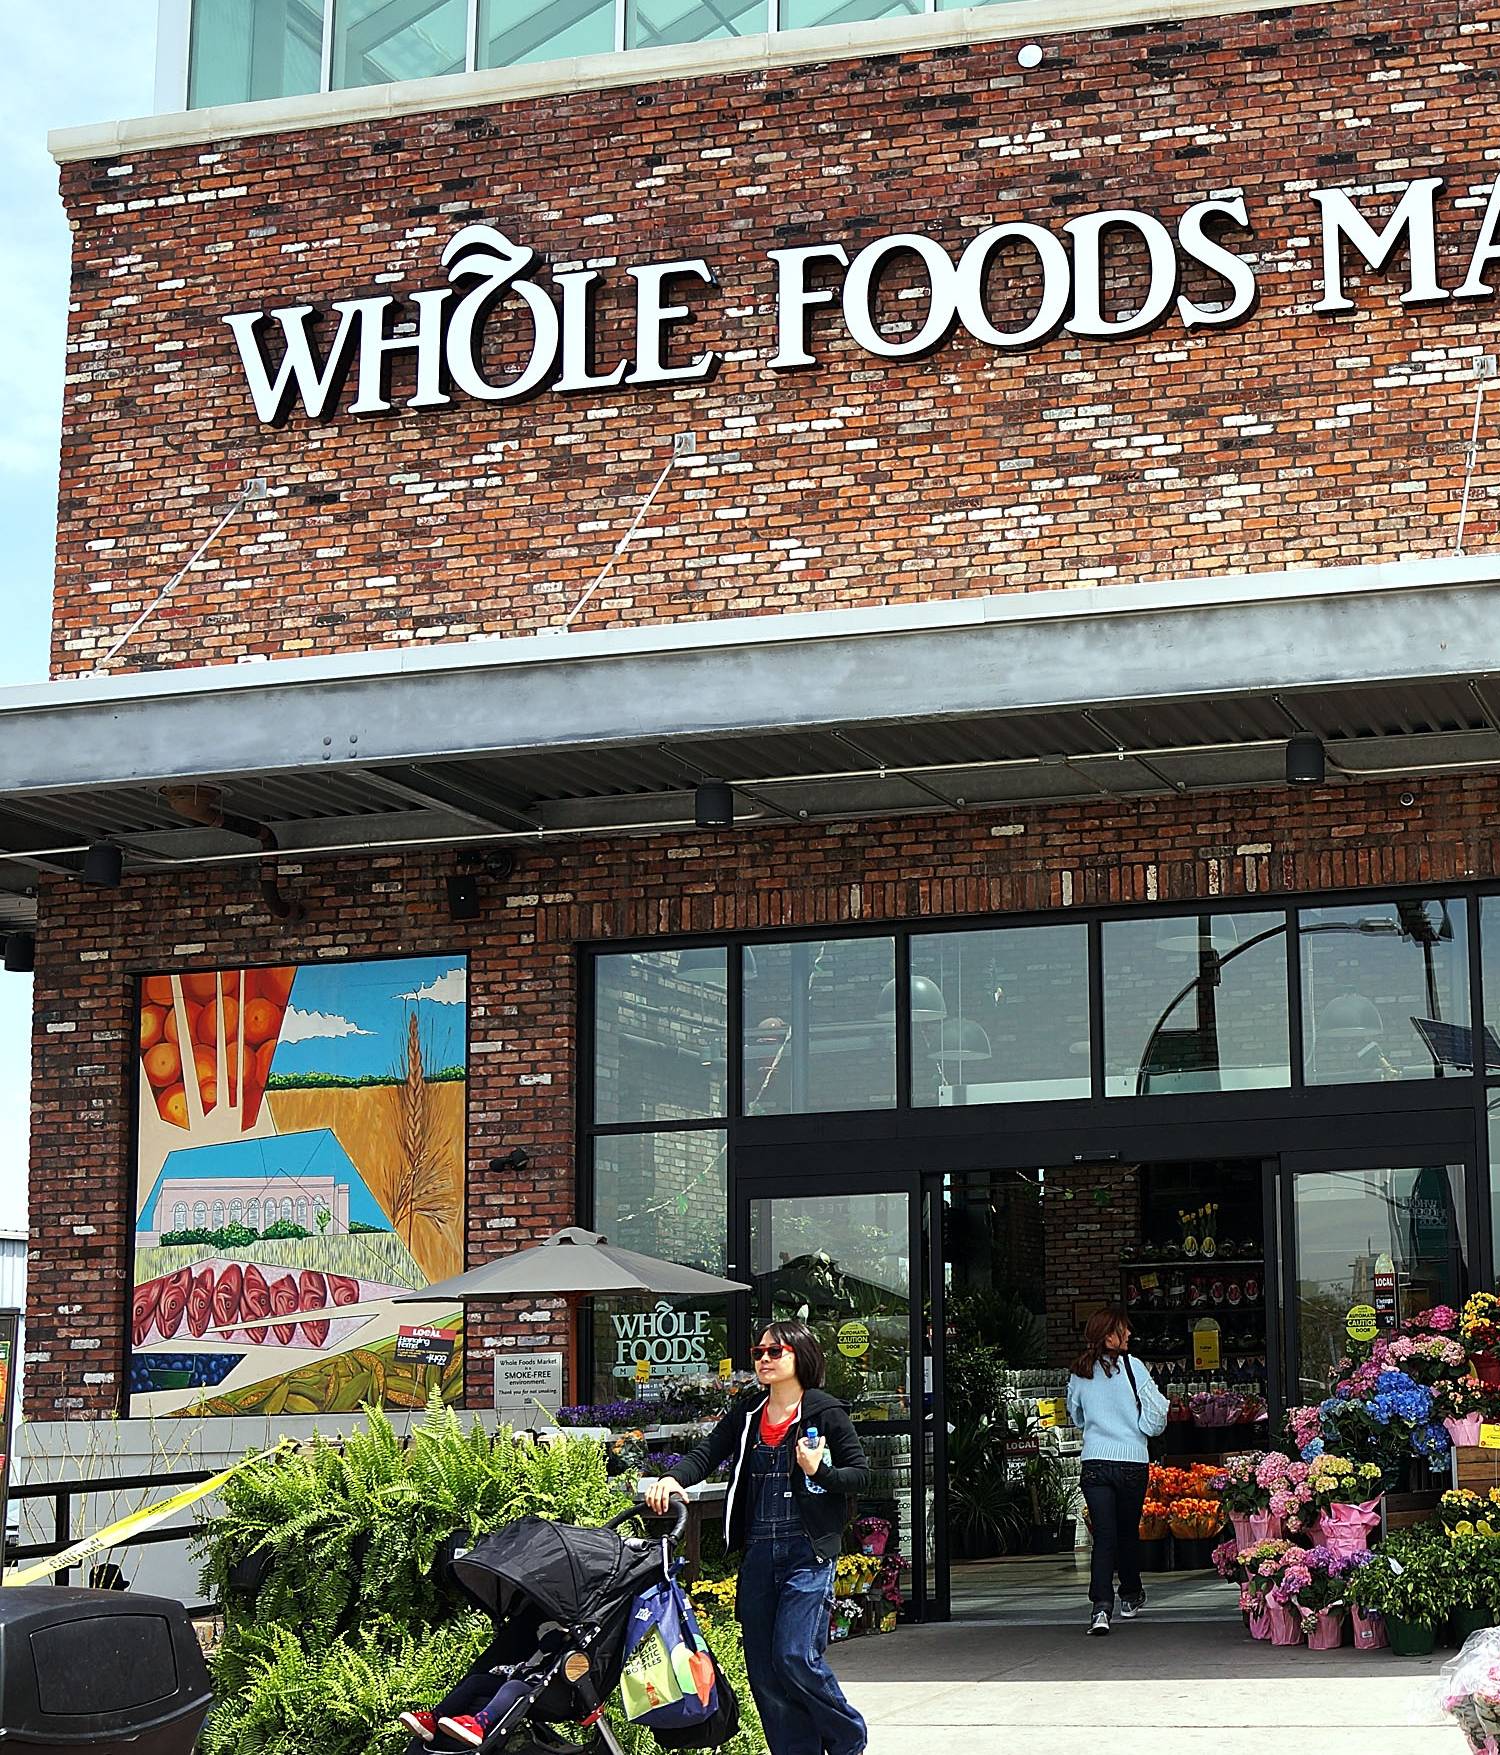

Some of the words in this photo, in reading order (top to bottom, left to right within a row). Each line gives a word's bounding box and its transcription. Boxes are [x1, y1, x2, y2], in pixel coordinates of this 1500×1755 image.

[222, 224, 717, 426] WHOLE
[766, 196, 1257, 370] FOODS
[1375, 1277, 1394, 1287] LOCAL
[610, 1300, 711, 1339] WHOLE
[412, 1328, 442, 1338] LOCAL
[615, 1337, 707, 1364] FOODS
[504, 1370, 551, 1379] SMOKE-FREE
[620, 1365, 702, 1375] MRKET
[1006, 1440, 1037, 1450] LOCAL
[626, 1657, 662, 1676] BOTLES
